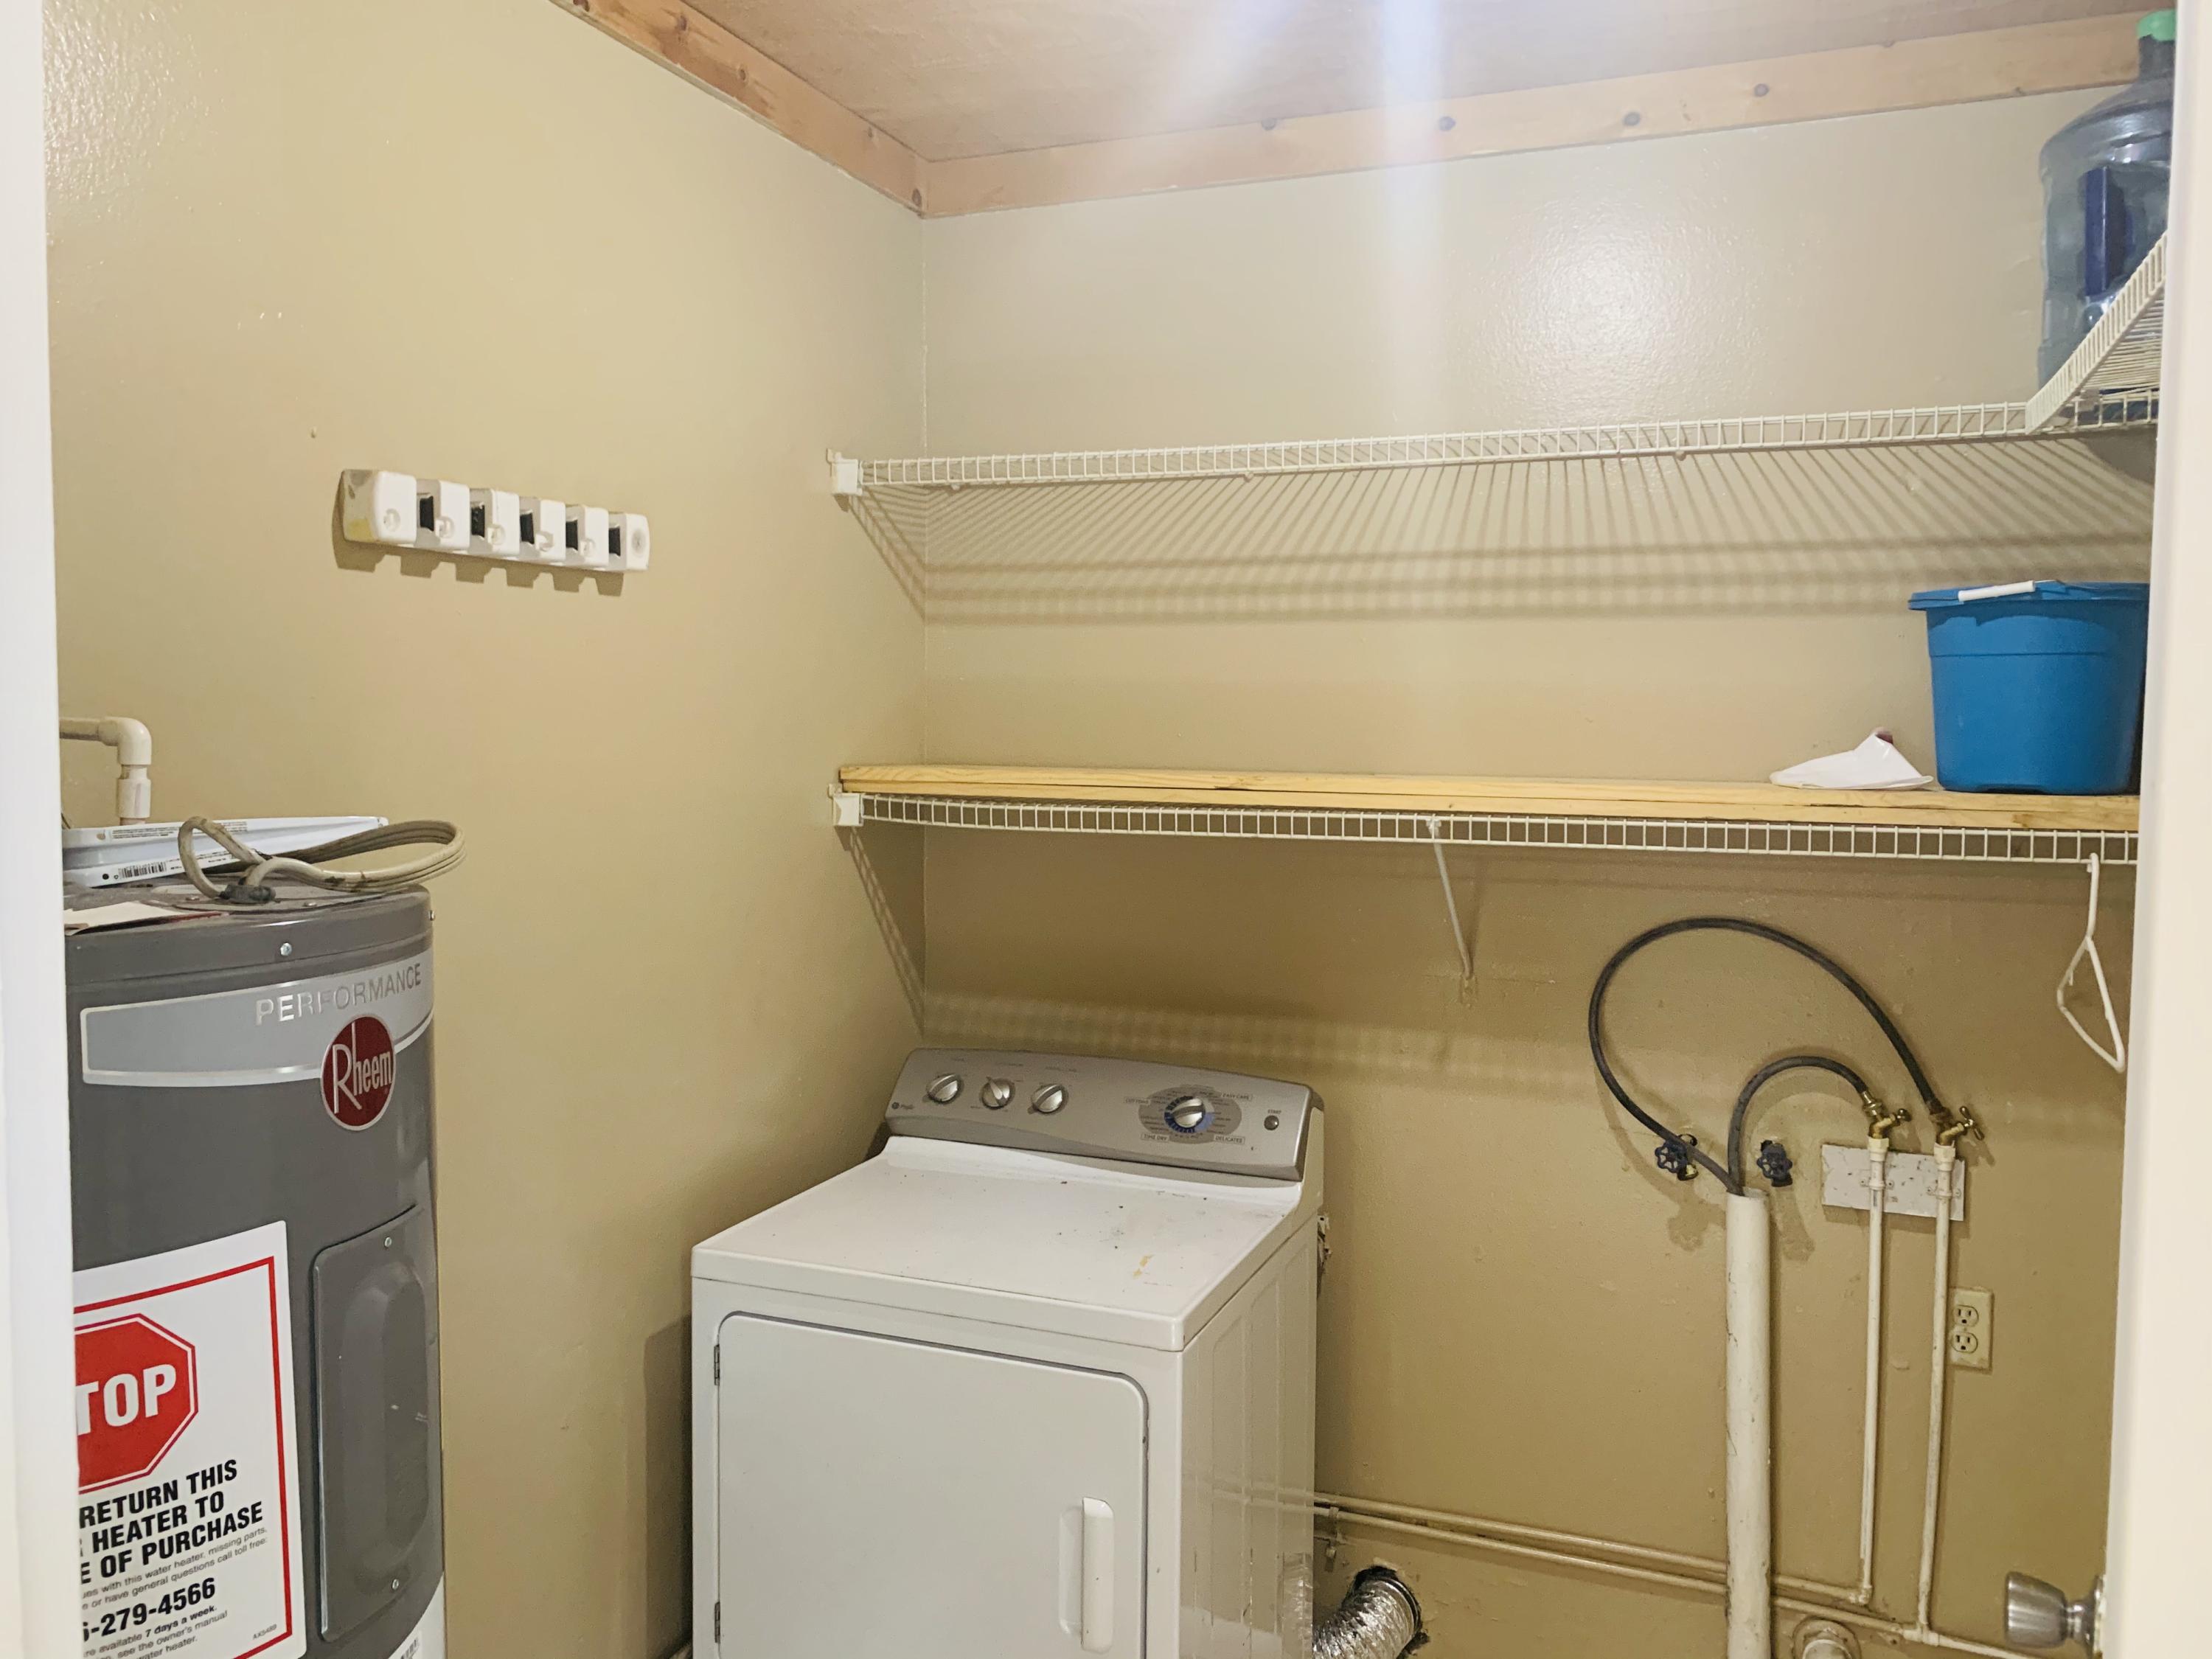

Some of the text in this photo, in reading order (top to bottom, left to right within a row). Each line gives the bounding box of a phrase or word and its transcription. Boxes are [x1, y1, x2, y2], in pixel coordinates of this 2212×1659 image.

[255, 963, 422, 1026] PERFORMANCE
[333, 1021, 392, 1114] Rheem
[79, 1458, 237, 1529] RETURN THIS
[92, 1504, 187, 1554] HEATER
[195, 1491, 224, 1519] TO
[100, 1549, 133, 1578] OF
[142, 1500, 263, 1565] PURCHASE
[102, 1581, 122, 1593] with
[125, 1574, 142, 1586] this
[145, 1563, 171, 1579] water
[208, 1537, 242, 1556] missing
[91, 1598, 102, 1608] or
[105, 1590, 129, 1604] have
[132, 1576, 169, 1597] general
[171, 1559, 215, 1582] questions
[218, 1551, 232, 1563] call
[234, 1545, 248, 1556] toll
[99, 1633, 143, 1653] available
[145, 1628, 151, 1638] 7
[154, 1620, 178, 1635] days
[139, 1641, 154, 1651] the
[156, 1626, 193, 1645] owner's
[195, 1610, 228, 1630] manual
